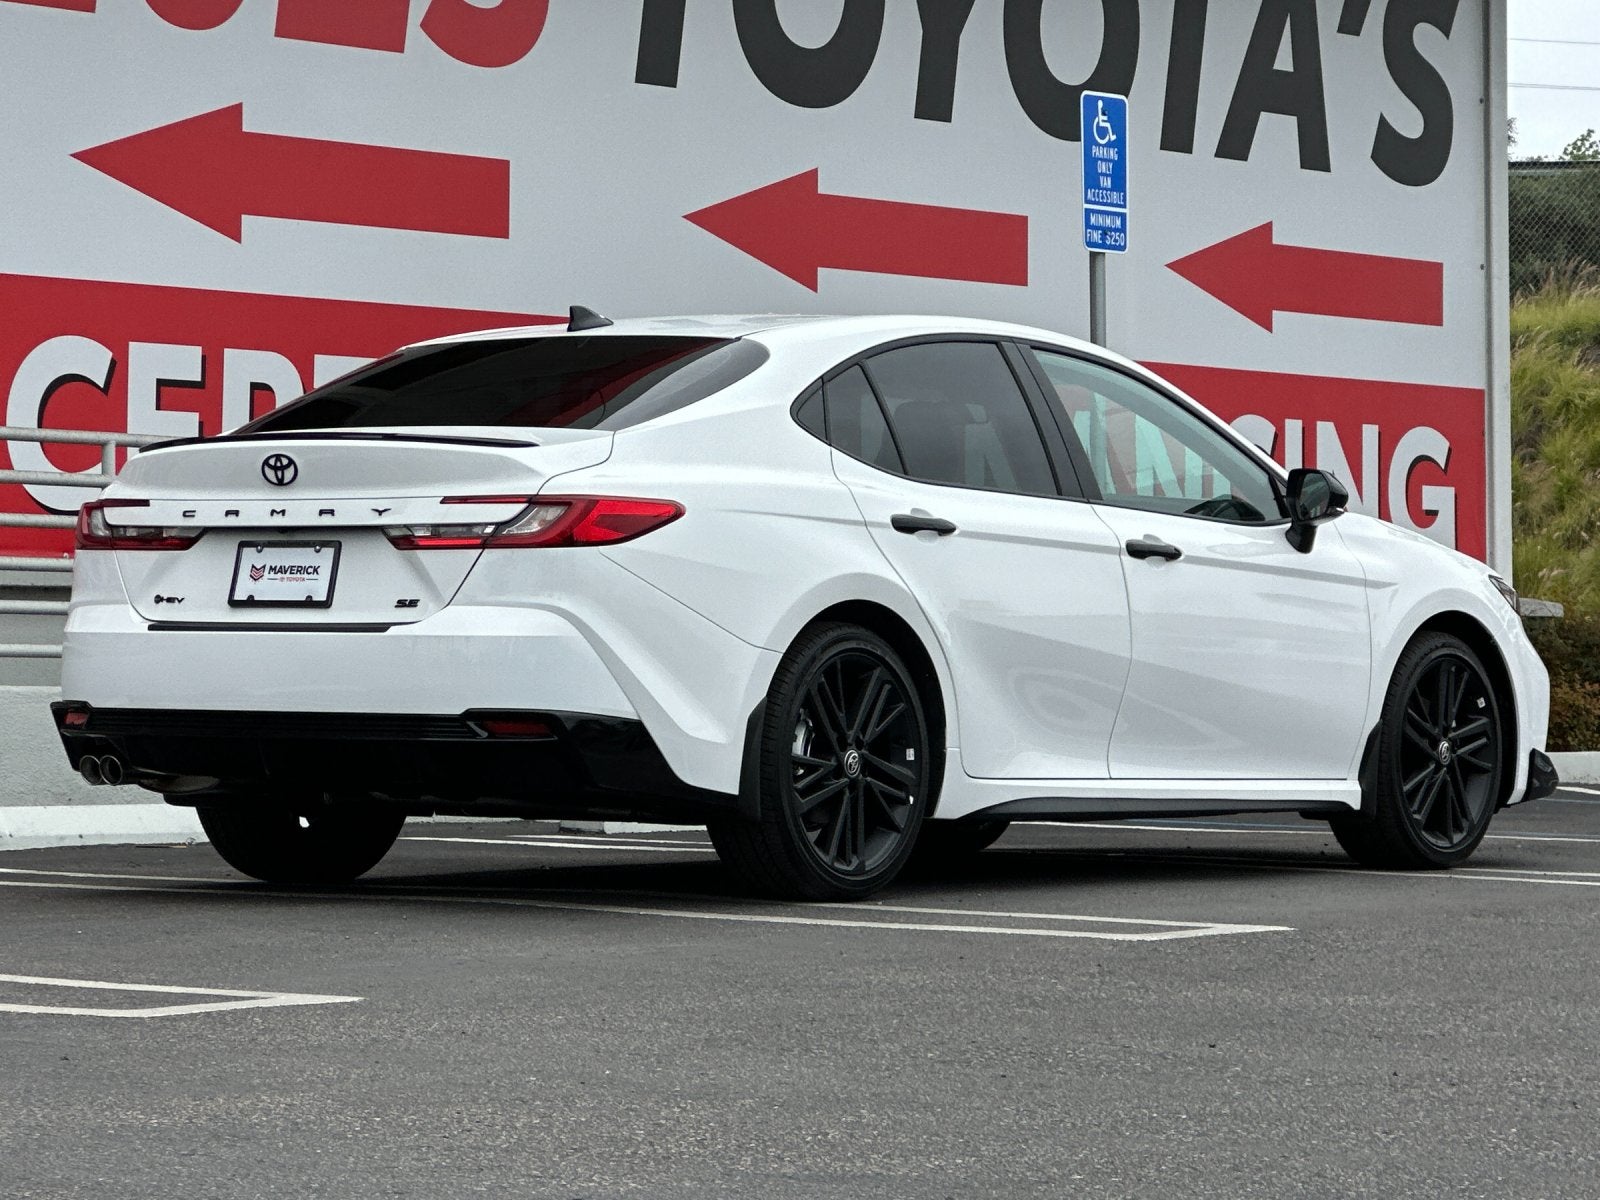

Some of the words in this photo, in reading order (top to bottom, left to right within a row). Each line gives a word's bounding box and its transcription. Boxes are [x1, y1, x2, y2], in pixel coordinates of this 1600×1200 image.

[1091, 145, 1118, 161] PARKING
[1097, 160, 1113, 174] ONLY
[1099, 176, 1112, 189] VAN
[1087, 188, 1125, 205] ACCESSIBLE
[1090, 213, 1122, 229] MINIMUM
[1086, 229, 1103, 244] FINE
[1105, 231, 1125, 246] $250
[182, 508, 392, 518] CAMRY
[268, 565, 320, 575] MAVERICK
[394, 599, 421, 608] SE
